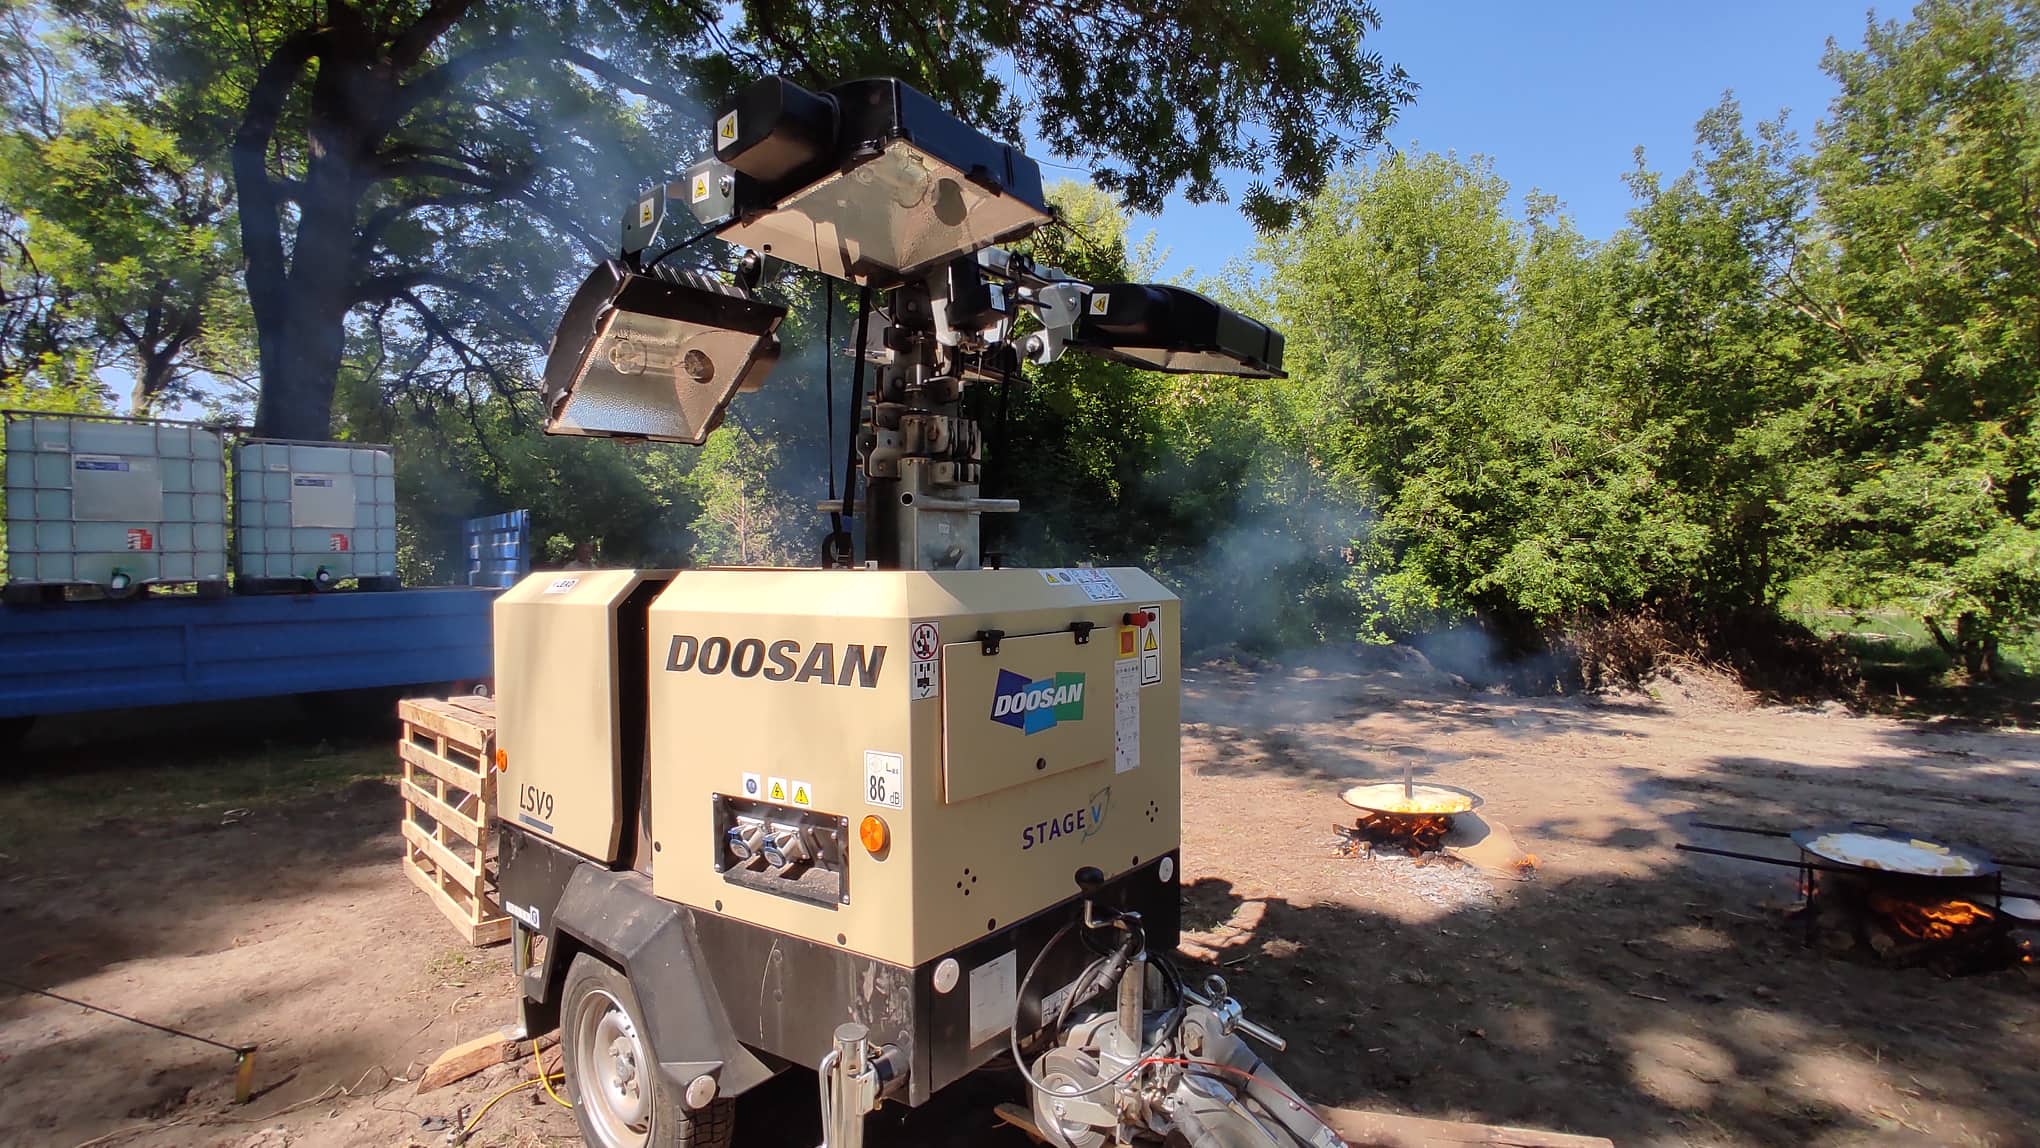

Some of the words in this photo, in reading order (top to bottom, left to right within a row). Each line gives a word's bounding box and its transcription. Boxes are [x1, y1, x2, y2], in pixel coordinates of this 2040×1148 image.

[665, 634, 887, 688] DOOSAN
[994, 683, 1083, 717] DOOSAN
[520, 783, 553, 820] LSV9
[870, 775, 885, 802] 86
[890, 791, 900, 805] dB
[1022, 808, 1085, 850] STAGE
[1091, 803, 1102, 823] V
